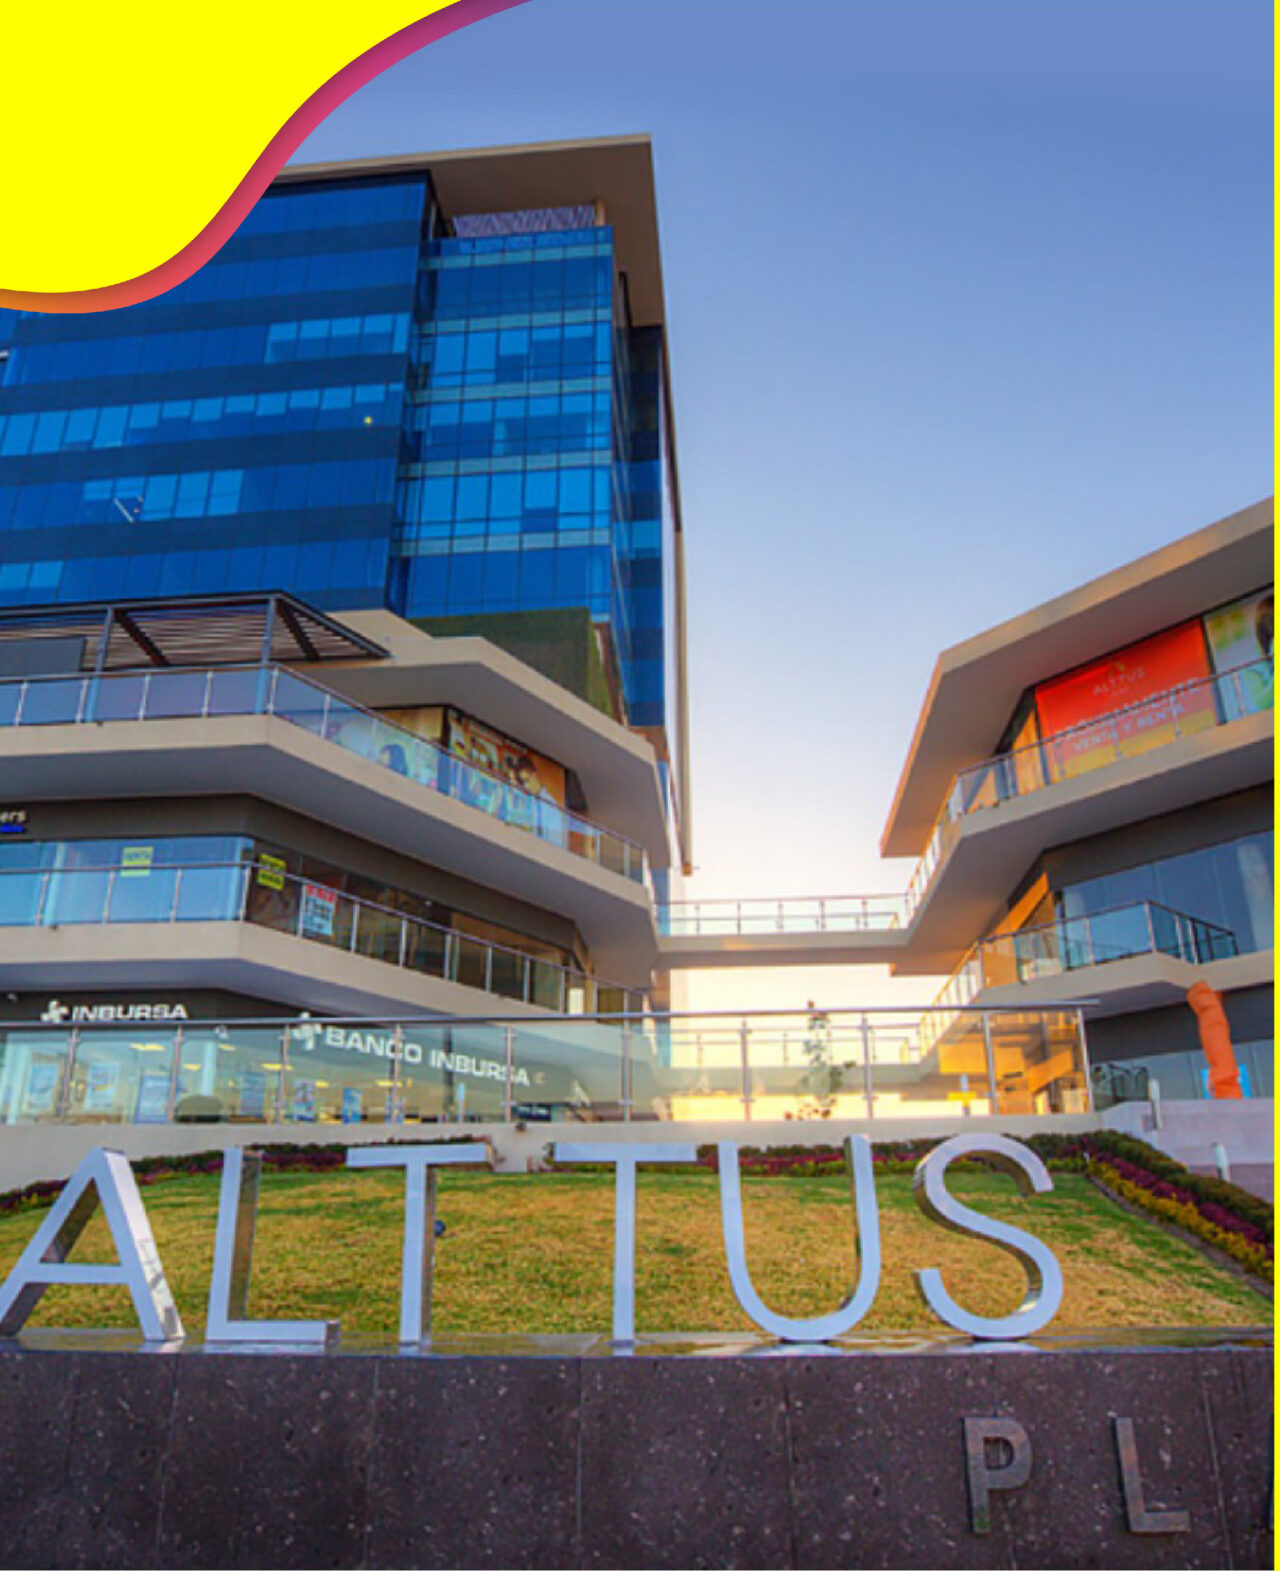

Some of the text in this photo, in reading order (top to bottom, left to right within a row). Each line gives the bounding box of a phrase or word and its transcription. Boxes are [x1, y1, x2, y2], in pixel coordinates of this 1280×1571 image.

[72, 1003, 188, 1020] INBURSA
[325, 1025, 530, 1087] BANCO INBURSA
[0, 1132, 1064, 1344] ALTTUS
